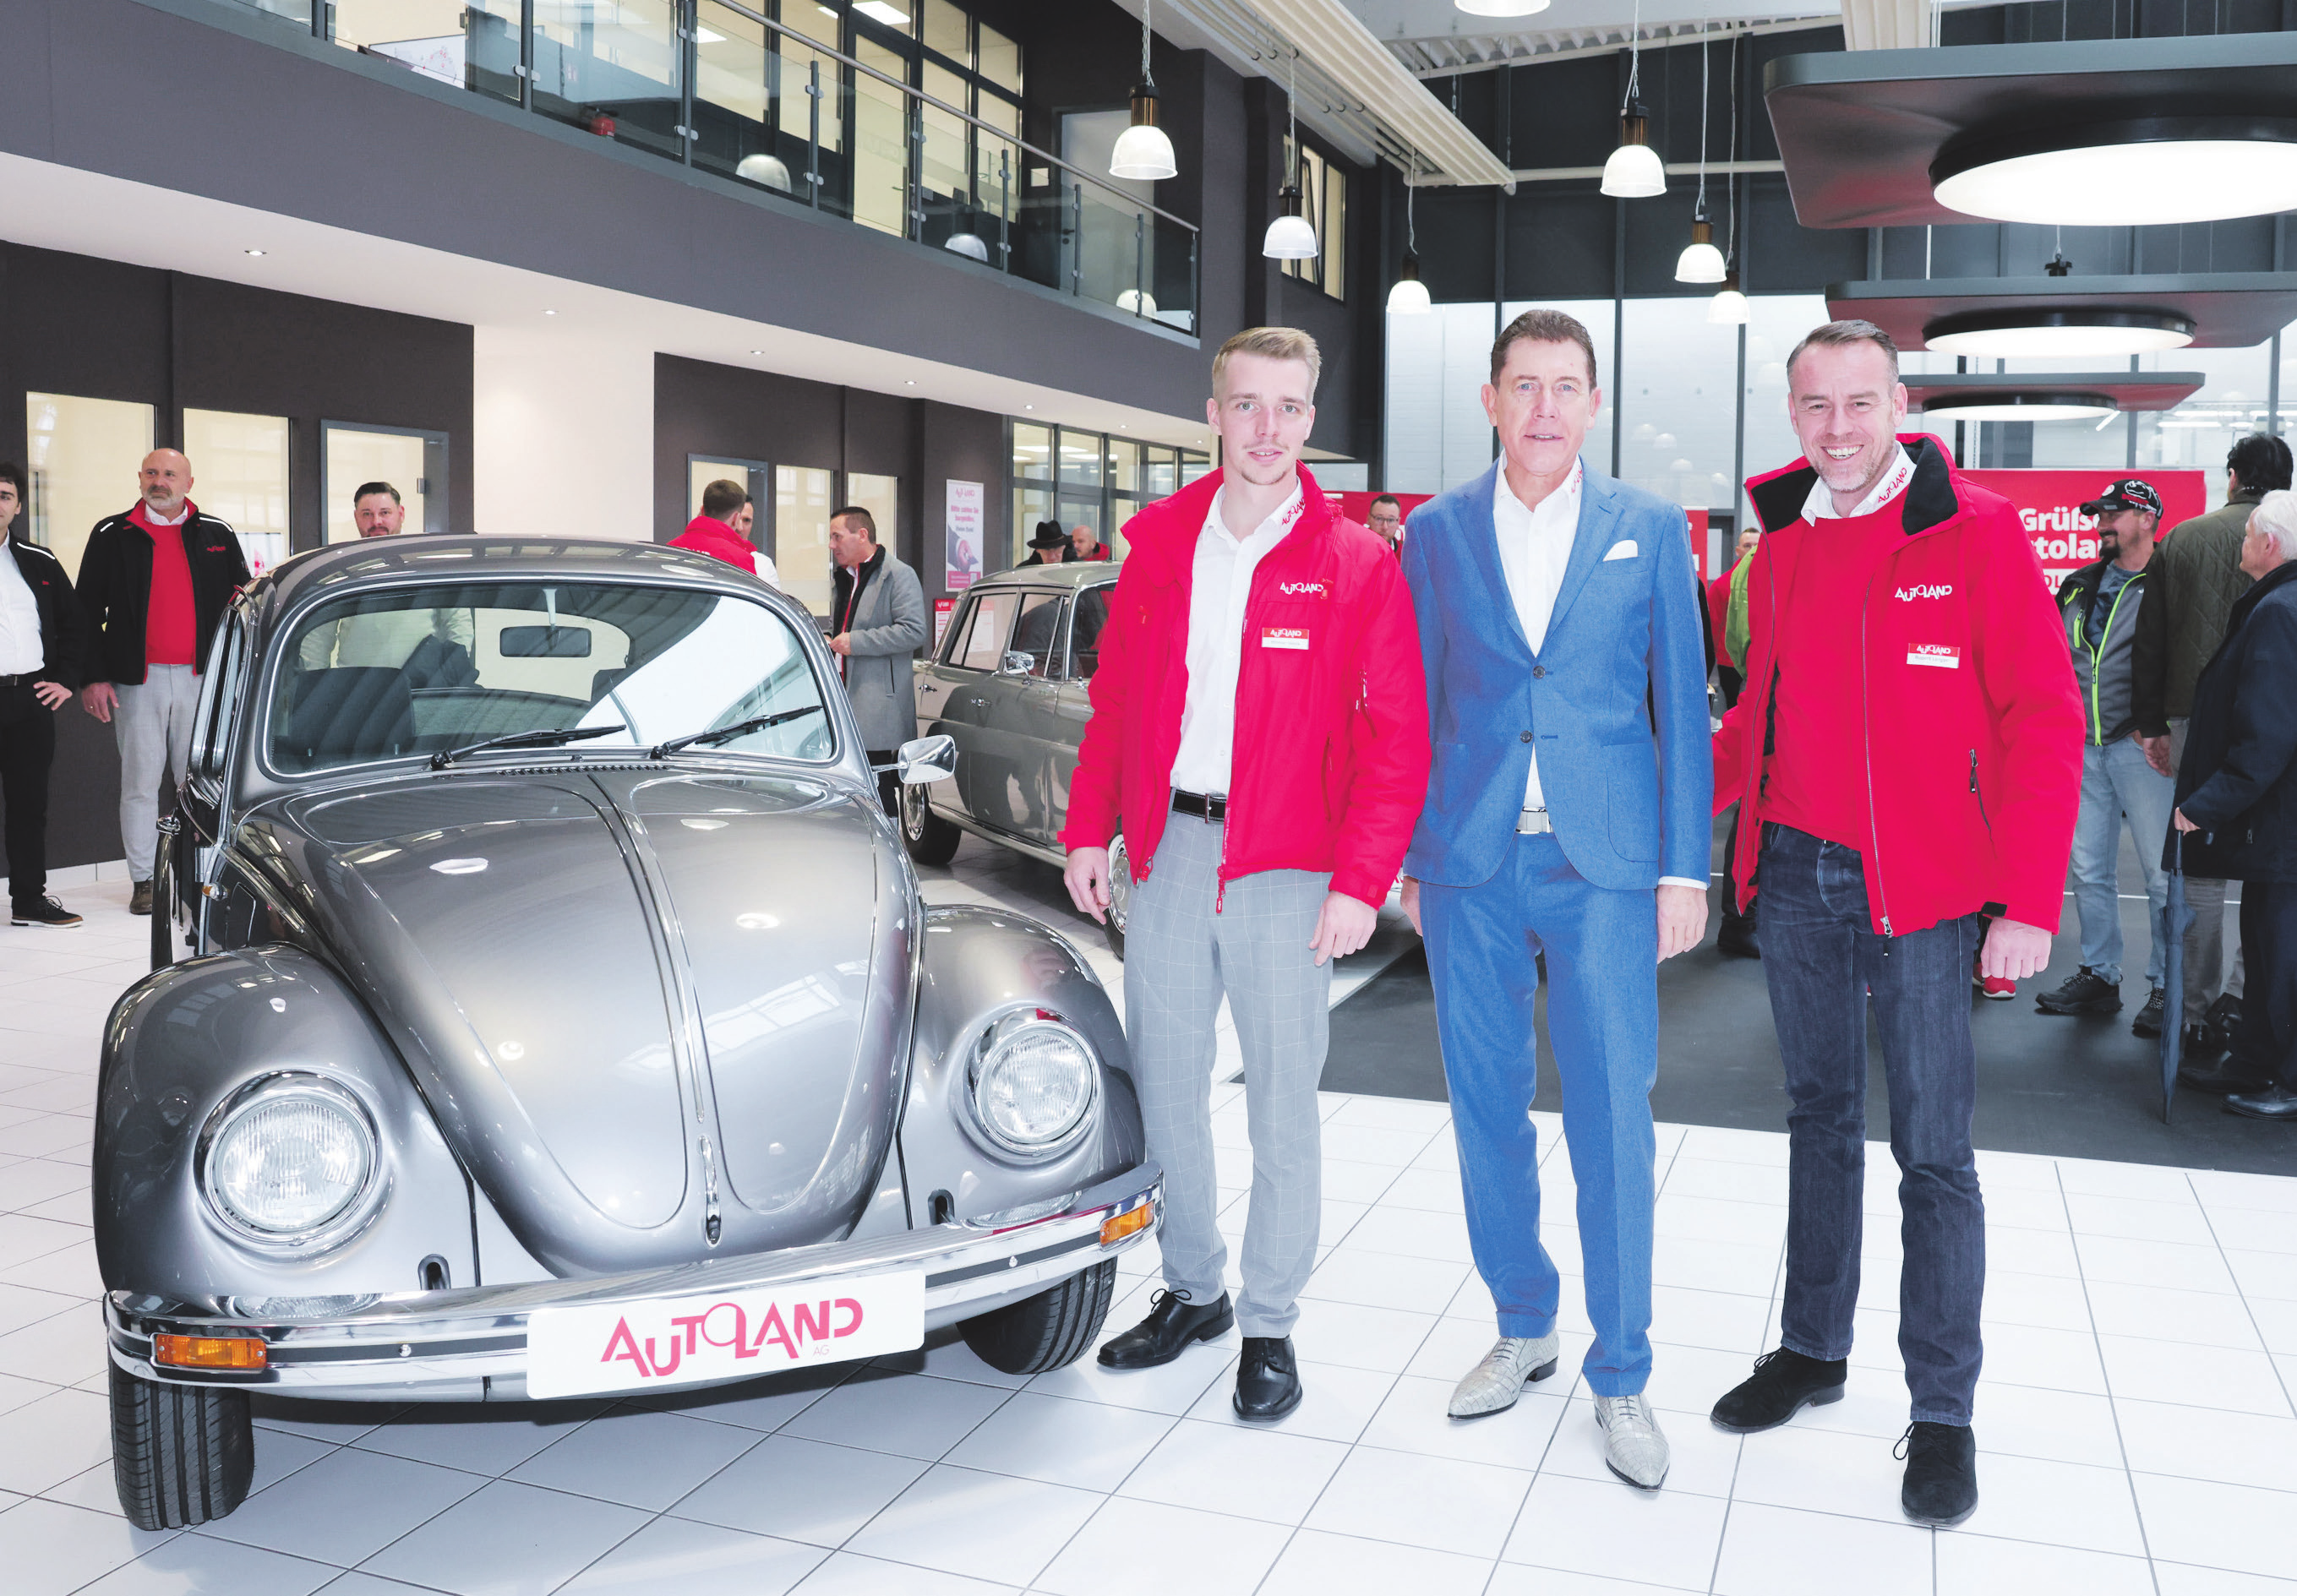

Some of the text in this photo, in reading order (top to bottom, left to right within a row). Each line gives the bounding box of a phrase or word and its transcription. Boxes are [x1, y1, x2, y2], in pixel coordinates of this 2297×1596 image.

[2031, 533, 2103, 559] tola
[1279, 581, 1324, 595] AUTOLAND
[1895, 584, 1953, 602] AUTOLAND
[1916, 645, 1951, 655] AUTOLAND
[601, 1298, 864, 1378] AUTOLAND
